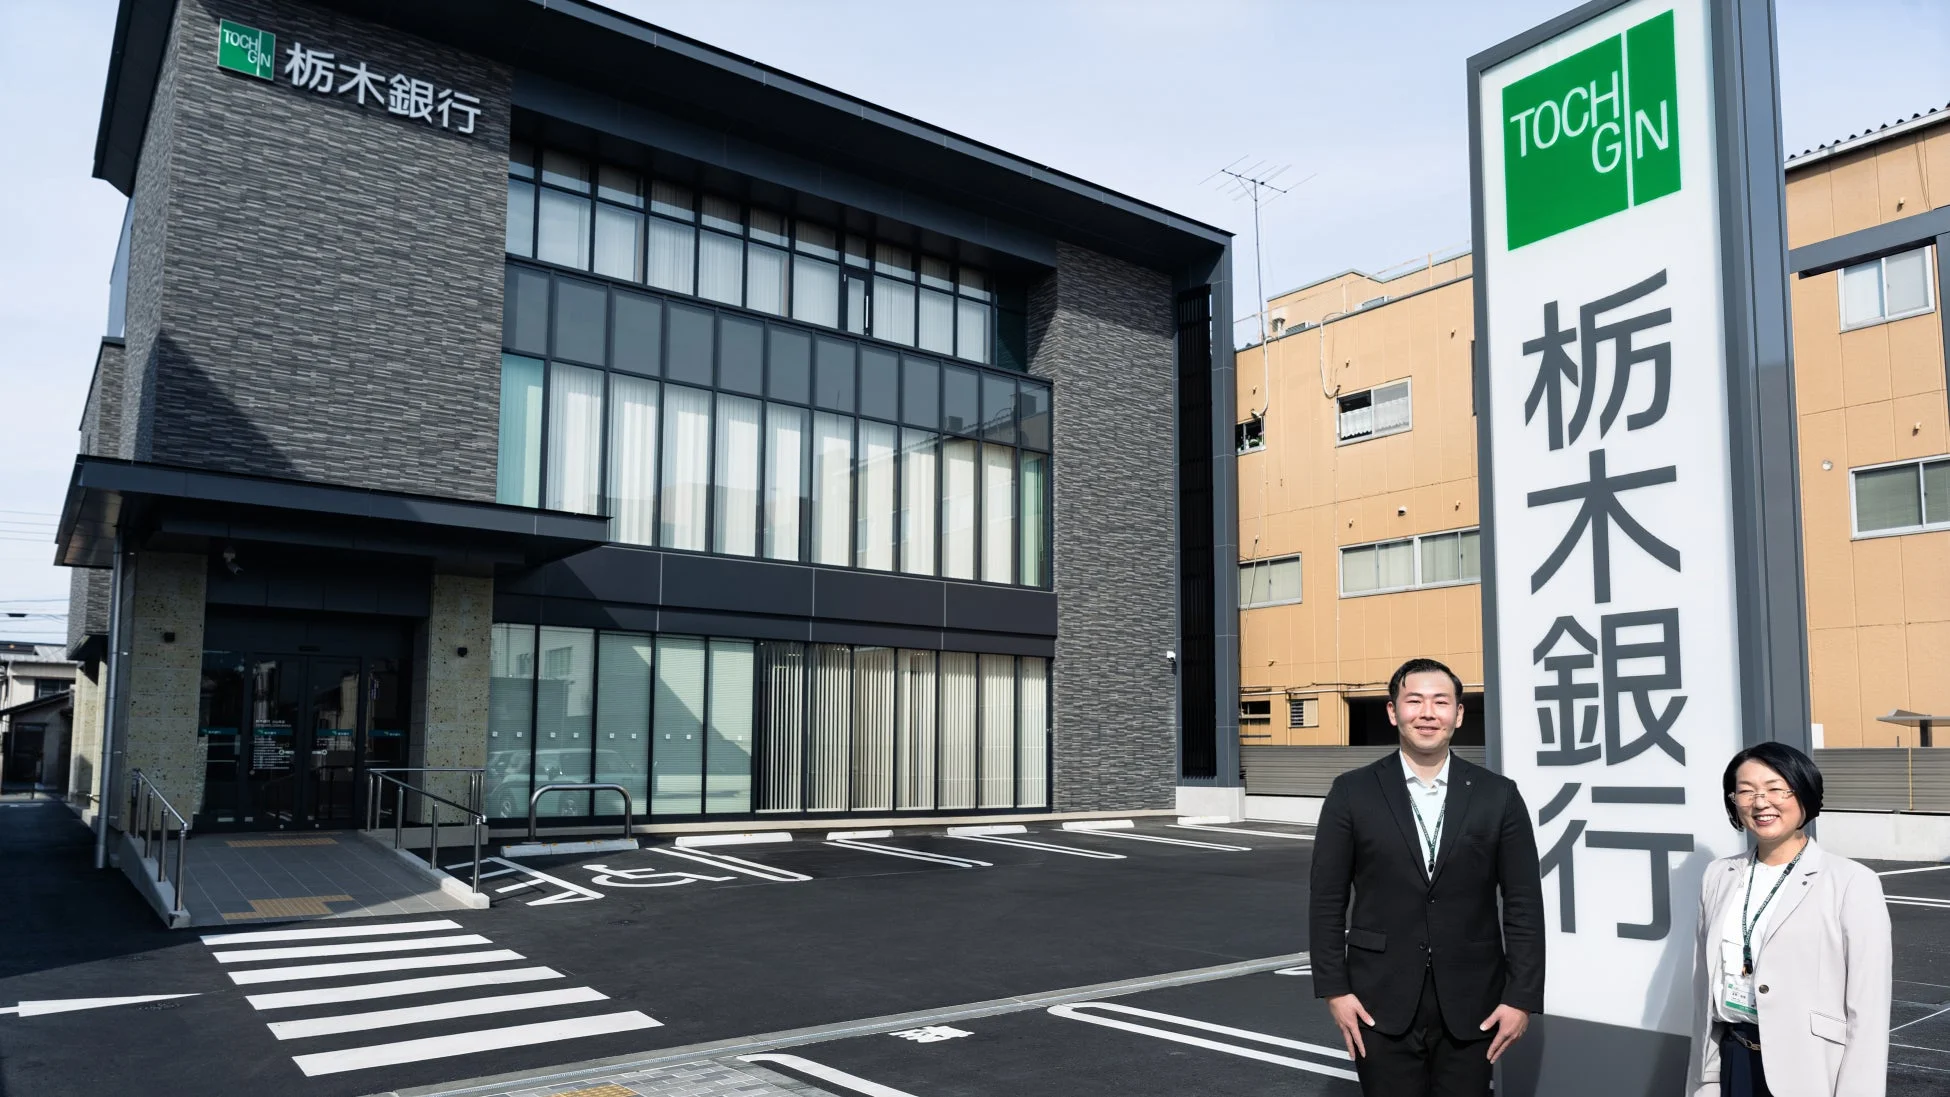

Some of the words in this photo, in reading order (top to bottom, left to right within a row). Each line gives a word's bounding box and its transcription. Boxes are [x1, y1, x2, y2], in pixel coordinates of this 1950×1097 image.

[284, 42, 482, 134] 栃木銀行
[1522, 268, 1695, 942] 栃木銀行
